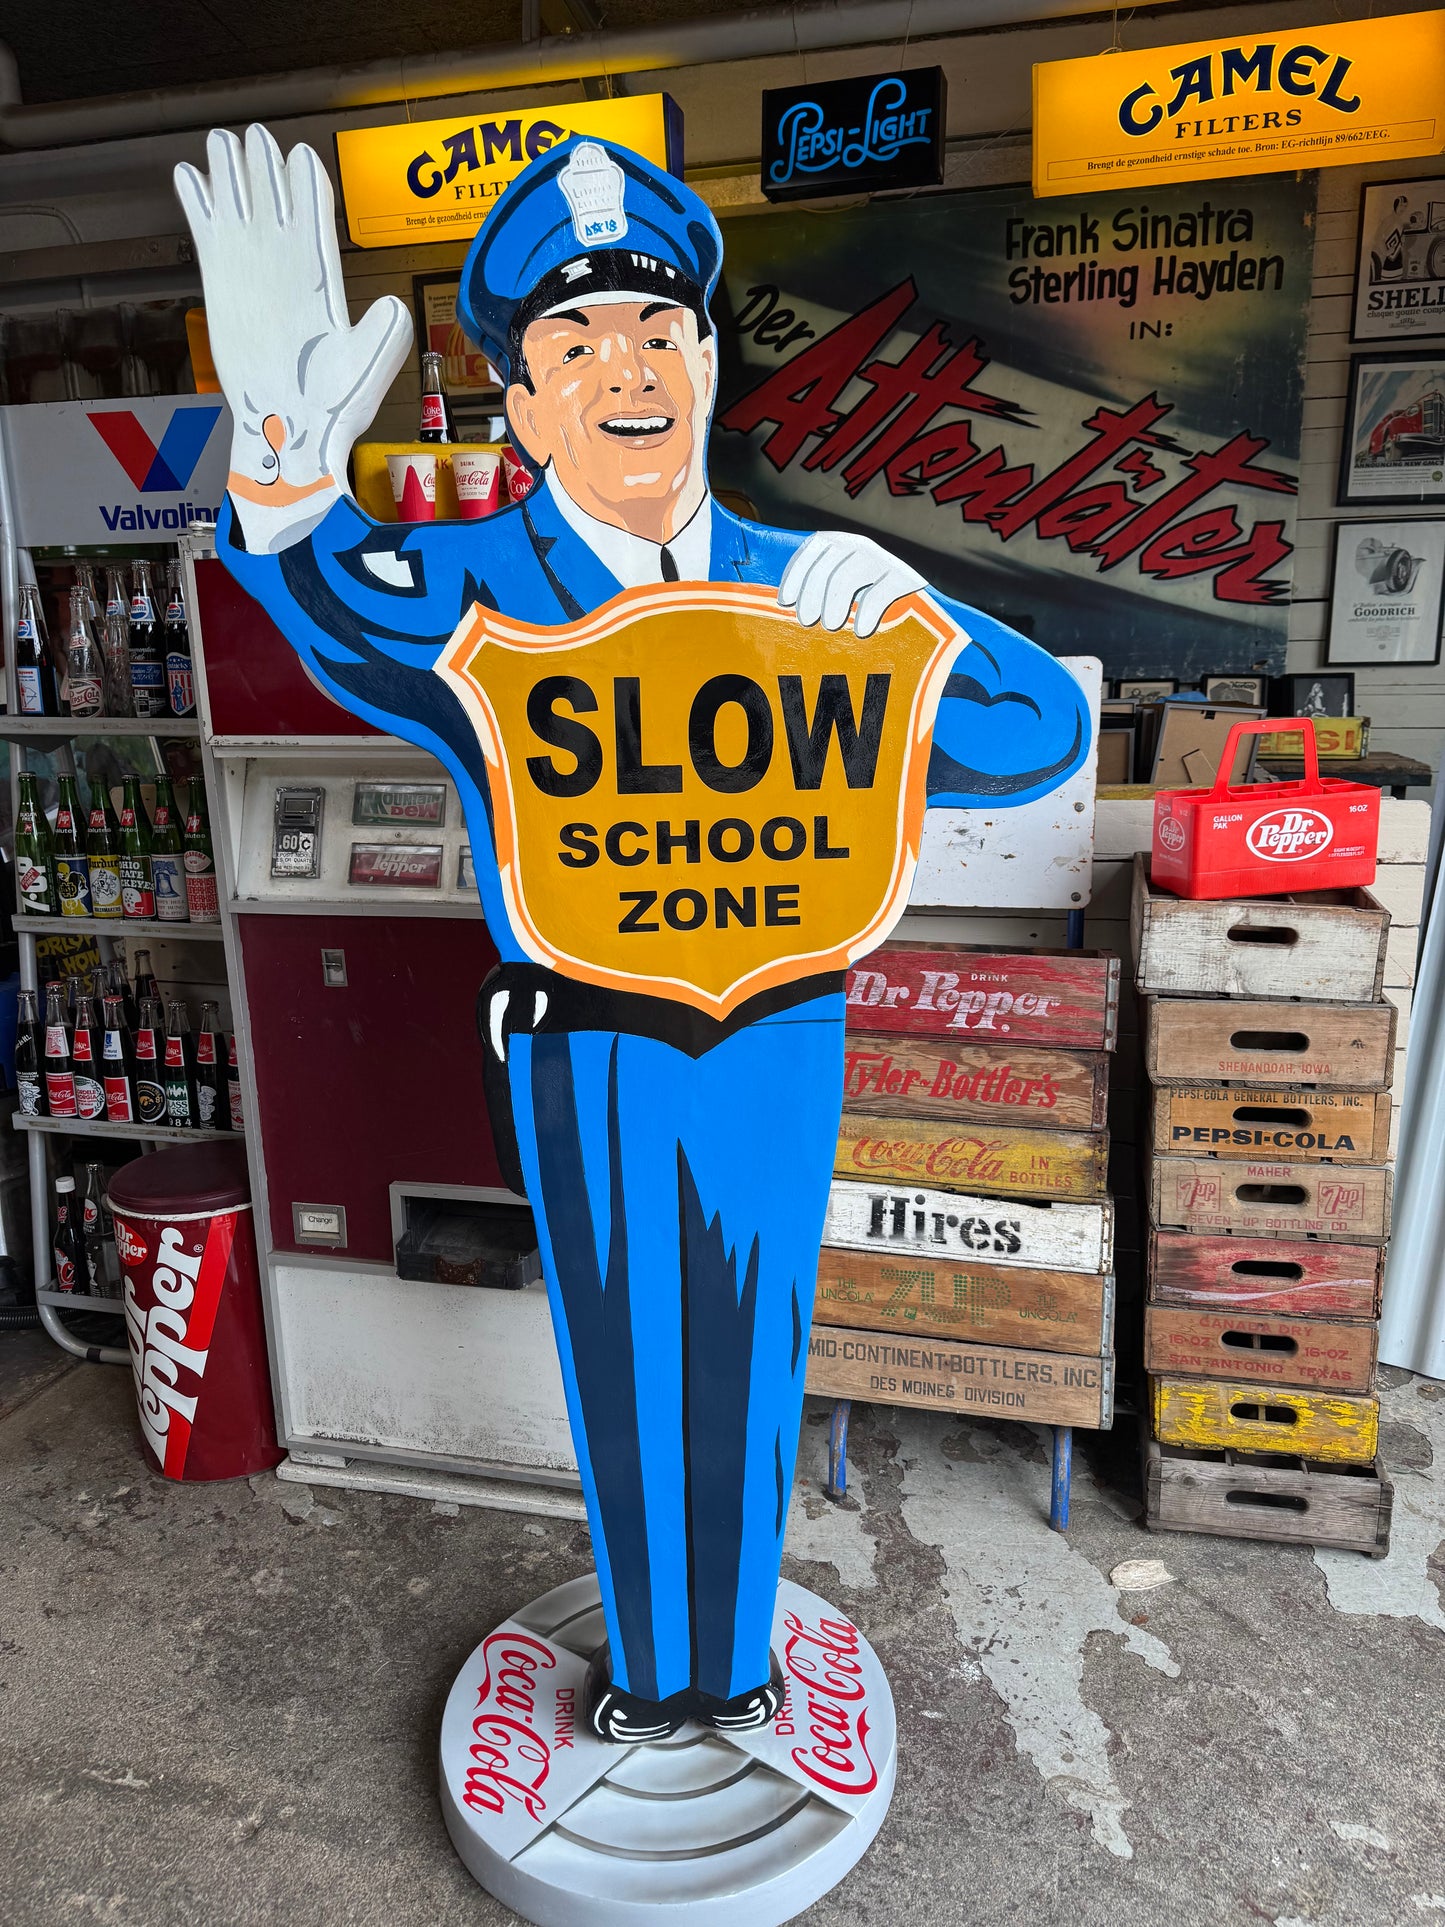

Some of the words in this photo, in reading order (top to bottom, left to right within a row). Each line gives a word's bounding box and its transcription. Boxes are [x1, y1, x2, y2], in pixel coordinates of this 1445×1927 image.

[1118, 43, 1362, 137] CAMEL
[1175, 109, 1303, 139] FILTERS
[407, 119, 580, 199] CAME
[1087, 160, 1114, 170] Brengt
[1116, 158, 1125, 167] de
[1127, 152, 1172, 167] gezondheid
[1174, 149, 1206, 162] ernstige
[1208, 146, 1236, 157] schade
[1238, 145, 1253, 154] toe.
[1255, 142, 1279, 152] Bron:
[1281, 135, 1333, 149] EG-richtlijn
[1335, 129, 1391, 143] 89/662/EEG.
[455, 181, 513, 200] FILT
[1006, 212, 1099, 260] Frank
[1112, 201, 1254, 252] Sinatra
[1008, 261, 1138, 308] Sterling
[1154, 250, 1284, 301] Hayden
[735, 283, 816, 353] Der
[1129, 320, 1173, 340] IN:
[423, 405, 441, 416] Coke
[456, 470, 490, 487] oca-Cola
[99, 502, 221, 531] Valvolin
[1354, 607, 1415, 617] GOODRICH
[525, 673, 892, 798] SLOW
[1258, 729, 1355, 752] EPSI
[1213, 813, 1243, 823] GALLON
[1213, 822, 1228, 830] PAK
[1281, 813, 1314, 833] Dr
[557, 815, 851, 868] SCHOOL
[1256, 824, 1327, 854] Pepper
[120, 870, 144, 879] TATE
[618, 884, 801, 934] ZONE
[970, 972, 1008, 982] DRINK
[846, 970, 910, 1008] Dr
[910, 970, 1062, 1030] Pepper
[1218, 1060, 1296, 1075] SHENANDOAH,
[1301, 1063, 1331, 1075] IOWA
[1171, 1088, 1229, 1102] PEPSI-COLA
[1234, 1091, 1278, 1104] GENERAL
[1283, 1093, 1337, 1107] BOTTLERS,
[1342, 1095, 1364, 1107] INC.
[1172, 1125, 1356, 1151] PEPSI-COLA
[1031, 1155, 1050, 1170] IN
[1247, 1166, 1292, 1177] MAHER
[1009, 1171, 1073, 1188] BOTTLES
[308, 1215, 333, 1225] Change
[866, 1194, 1022, 1254] Hires
[1190, 1214, 1259, 1228] SEVEN-UP
[1265, 1218, 1324, 1231] BOTTLING
[837, 1276, 857, 1290] THE
[1199, 1316, 1272, 1335] CANADA
[1278, 1324, 1313, 1337] DRY
[950, 1354, 1058, 1386] BOTTLERS,
[1064, 1367, 1100, 1389] INC.
[1168, 1354, 1202, 1366] SAN
[1210, 1357, 1284, 1374] ANTONIO
[1297, 1365, 1353, 1381] TEXAS
[870, 1375, 897, 1392] DES
[902, 1379, 955, 1398] MOINES
[964, 1388, 1026, 1408] DIVISION
[783, 1609, 879, 1796] Coca-Cola
[462, 1632, 557, 1825] Coca-Cola
[553, 1687, 576, 1751] DRINK
